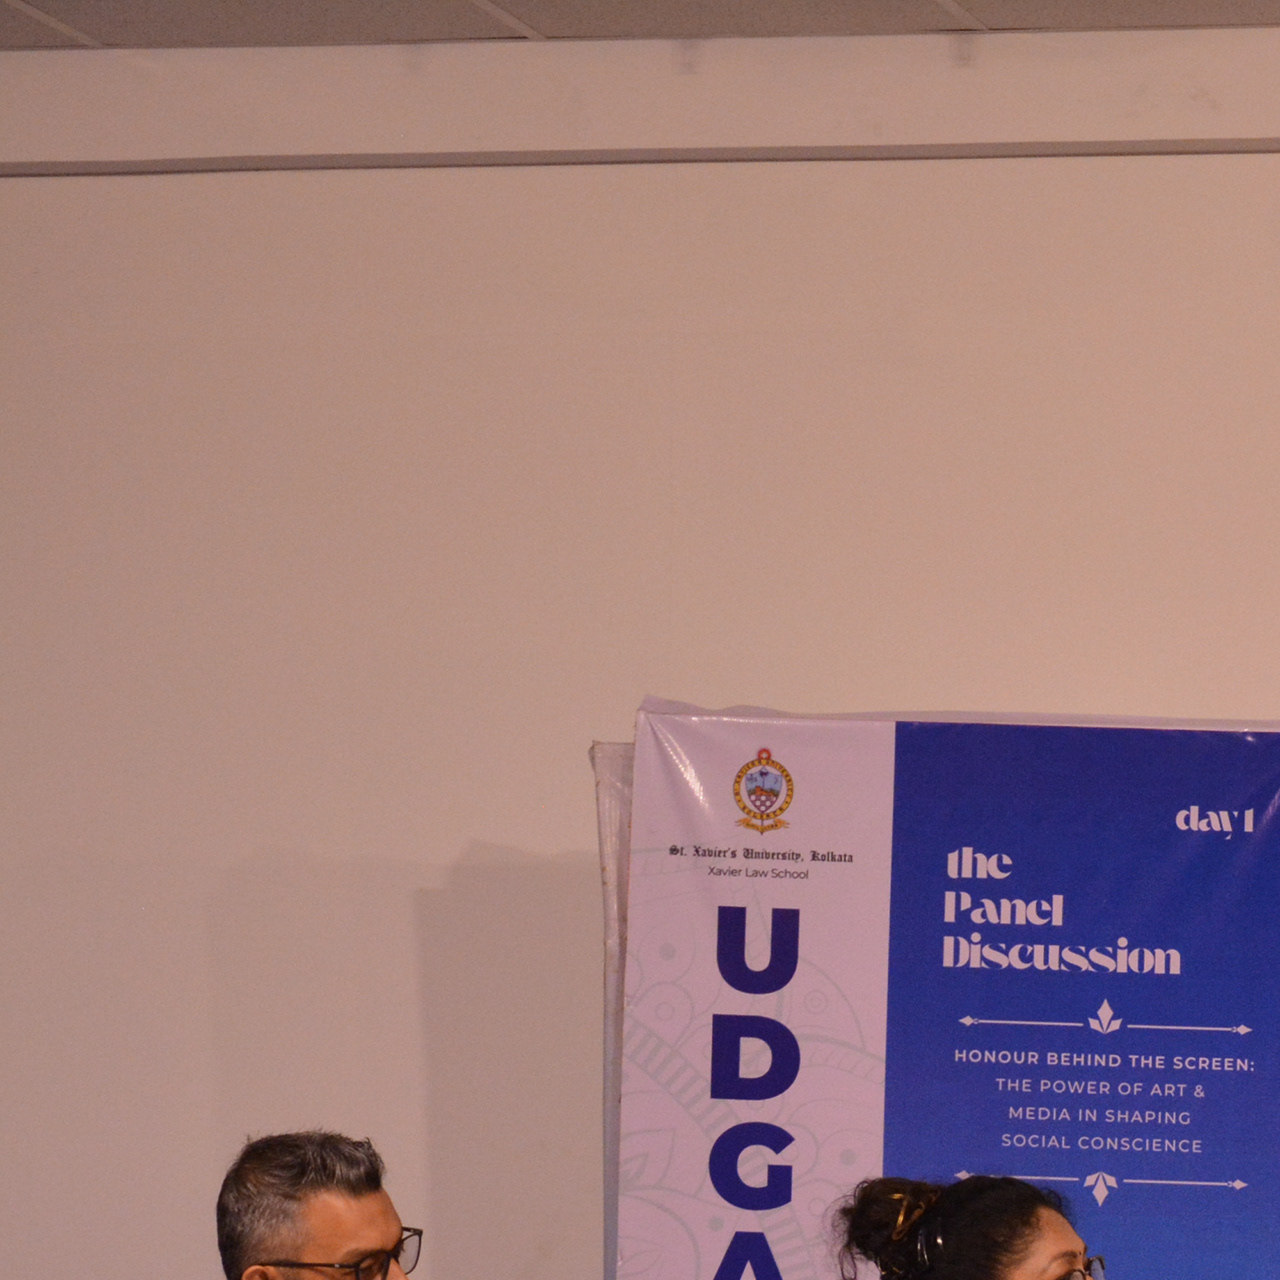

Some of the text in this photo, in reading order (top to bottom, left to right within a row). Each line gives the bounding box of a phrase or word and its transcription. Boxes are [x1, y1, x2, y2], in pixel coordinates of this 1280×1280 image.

[669, 845, 853, 863] St. Xavier's University, Kolkata
[948, 847, 1012, 879] the
[708, 866, 809, 879] Xavier Law School
[944, 891, 1063, 926] Panel
[943, 932, 1180, 974] Discussion
[955, 1050, 1254, 1071] HONOUR BEHIND THE SCREEN:
[996, 1078, 1204, 1097] THE POWER OF ART &
[1009, 1107, 1190, 1125] MEDIA IN SHAPING
[1002, 1134, 1202, 1153] SOCIAL CONSCIENCE
